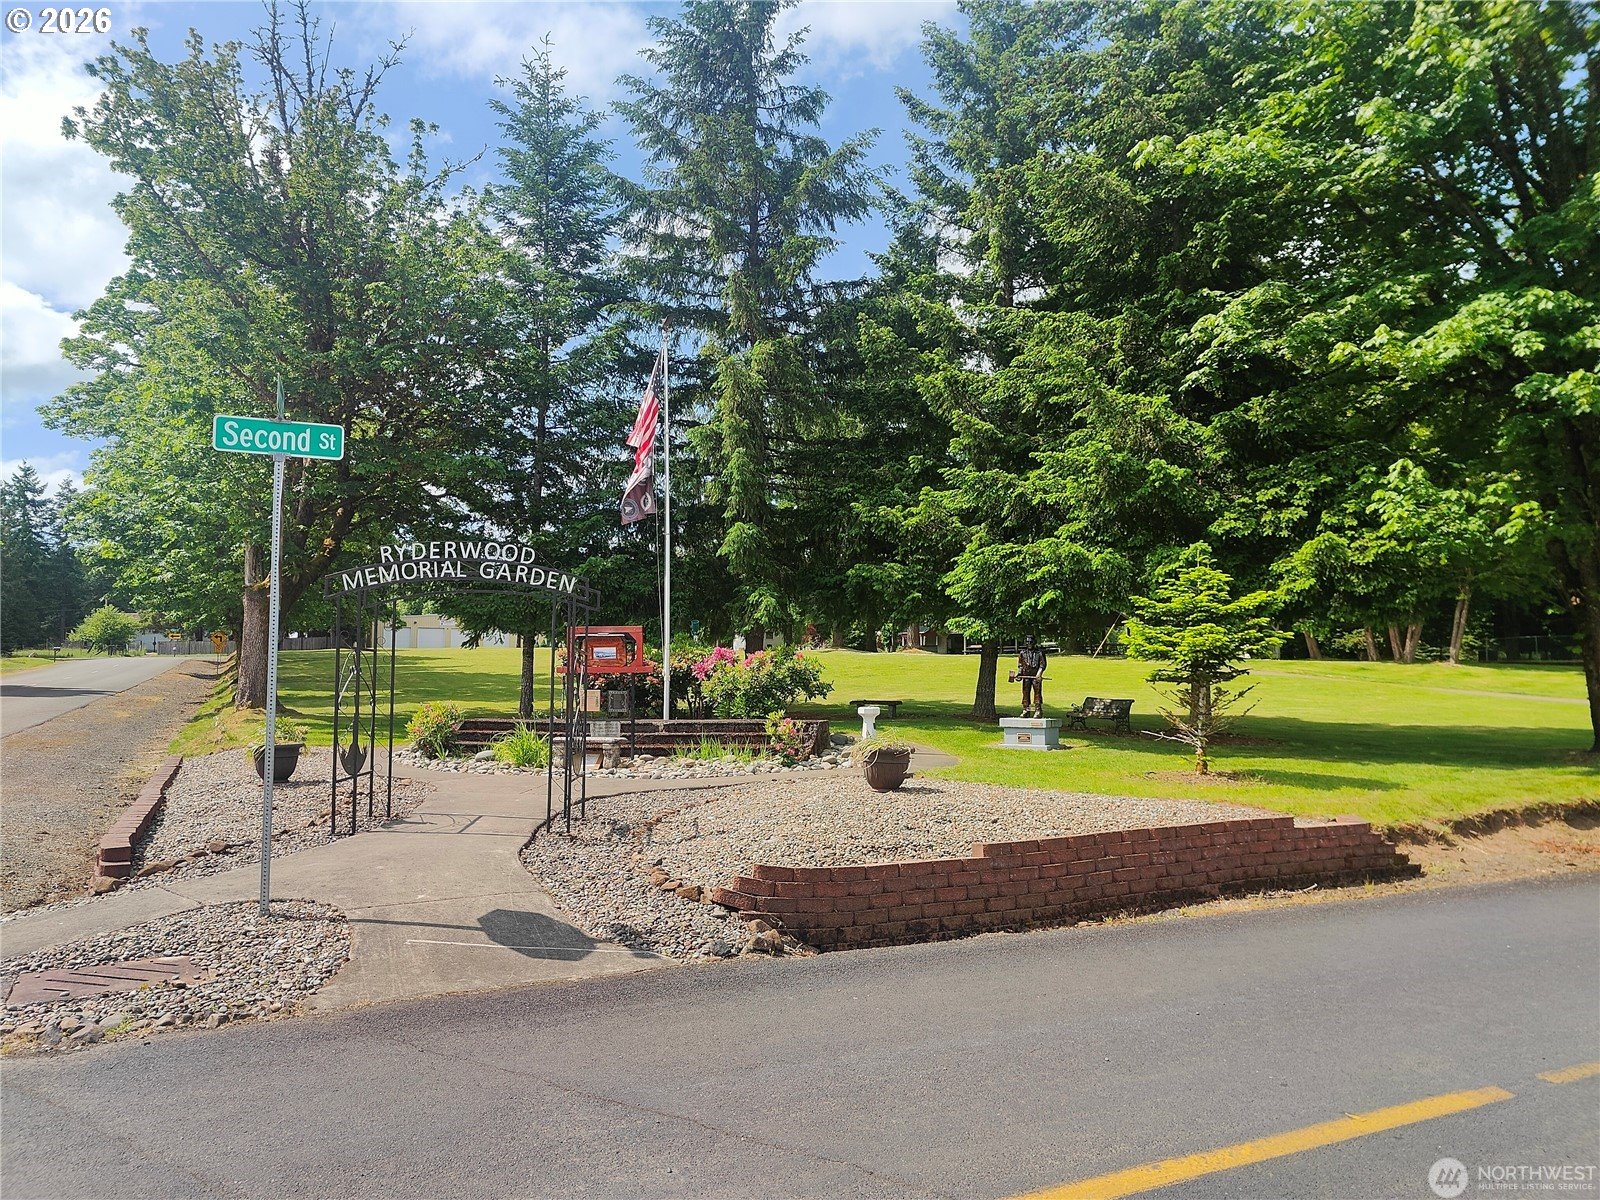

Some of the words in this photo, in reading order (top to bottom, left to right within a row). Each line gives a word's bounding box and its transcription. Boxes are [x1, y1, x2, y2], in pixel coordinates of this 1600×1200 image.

[222, 421, 311, 452] Second
[319, 432, 337, 451] St
[380, 541, 536, 565] RYDERWOOD
[341, 560, 468, 591] MEMORIAL
[479, 563, 577, 594] GARDEN
